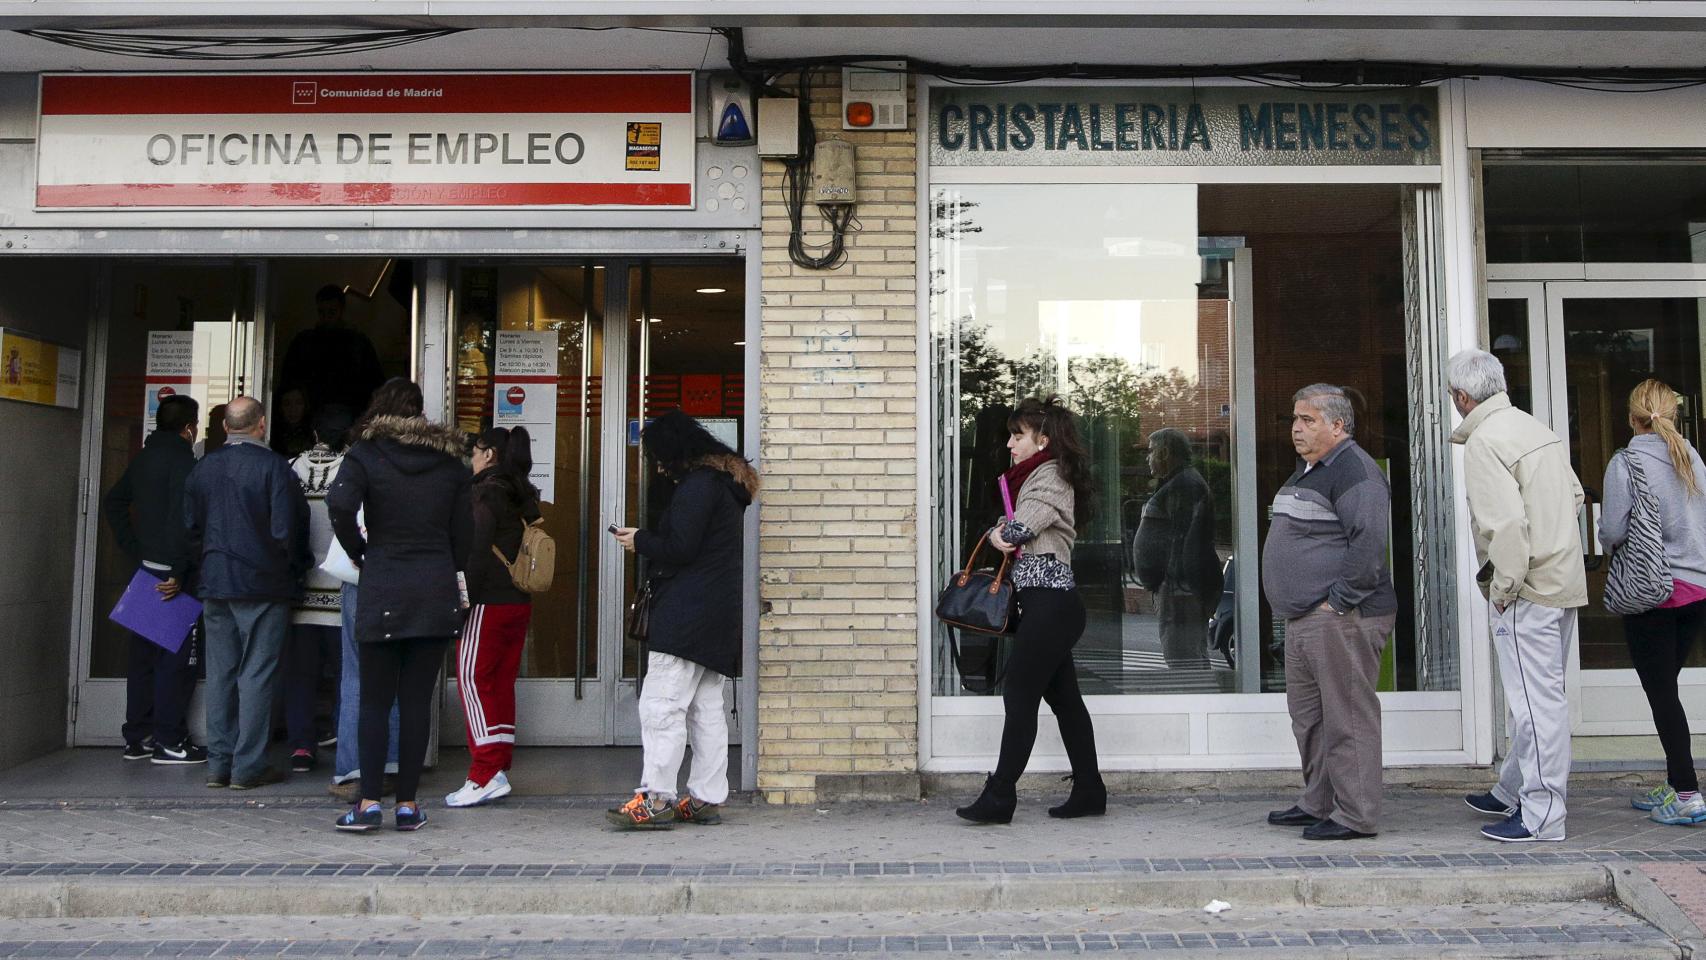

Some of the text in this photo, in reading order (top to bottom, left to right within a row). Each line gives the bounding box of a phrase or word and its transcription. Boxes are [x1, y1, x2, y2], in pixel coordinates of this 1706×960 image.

[320, 88, 442, 98] Comunidad de Madrid
[938, 103, 1432, 152] CRISTALERIA MENESES
[146, 132, 585, 166] OFICINA DE EMPLEO
